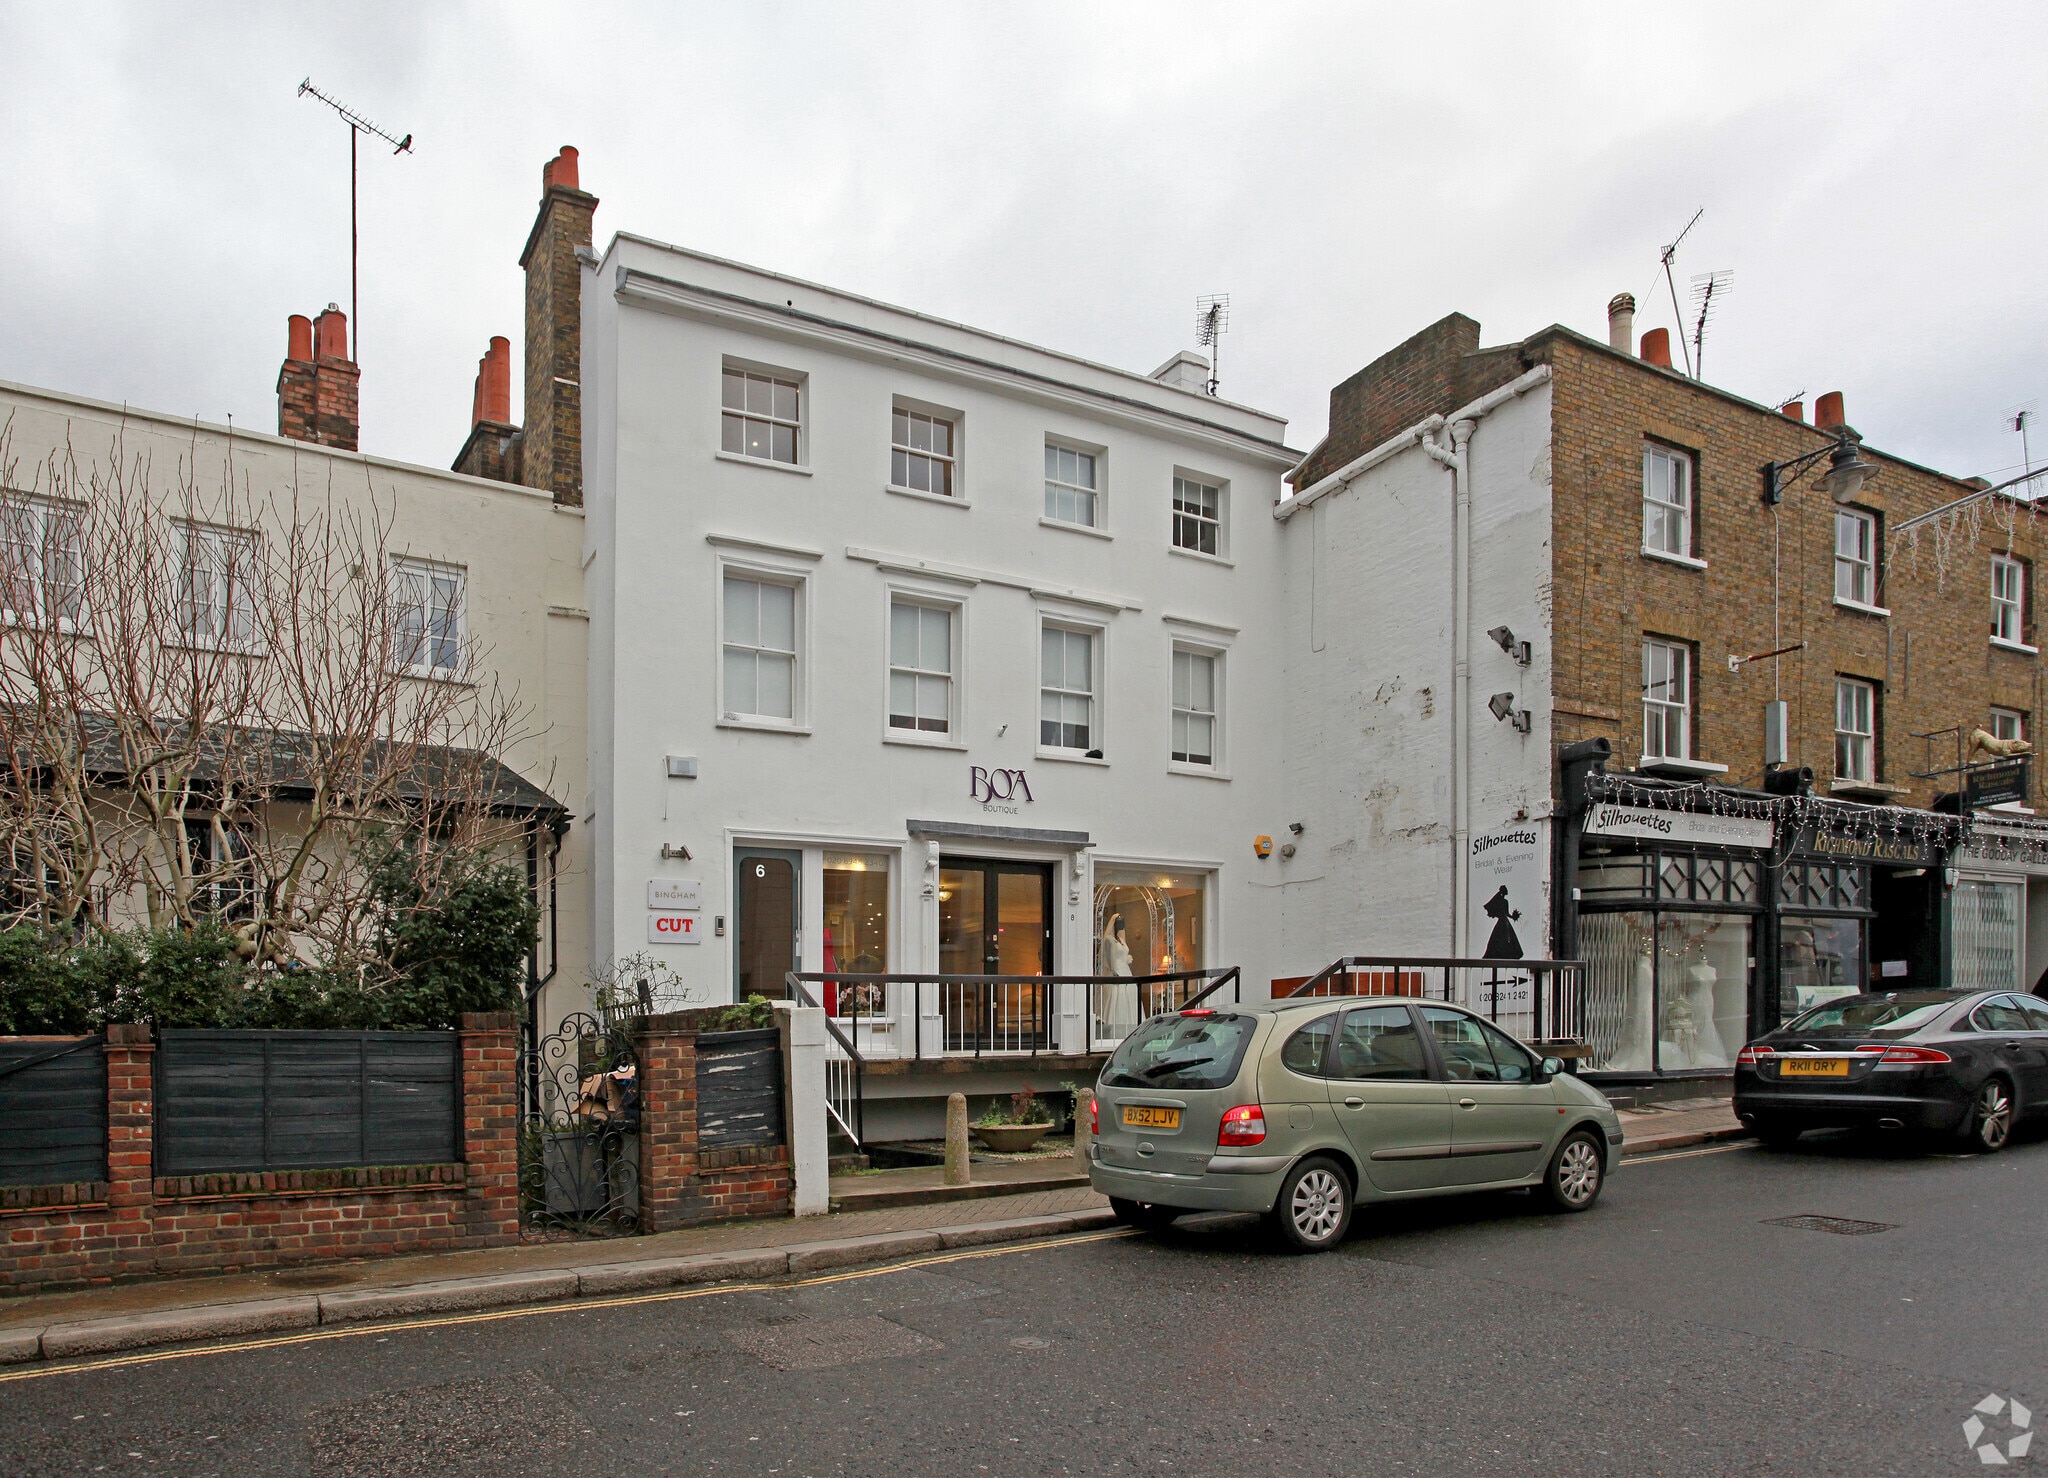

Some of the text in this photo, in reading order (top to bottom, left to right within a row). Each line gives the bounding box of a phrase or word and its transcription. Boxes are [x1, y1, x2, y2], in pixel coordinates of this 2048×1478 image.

[970, 766, 1034, 803] BOA
[983, 805, 1018, 814] BOUTIQUE
[1597, 809, 1672, 834] Silhouettes
[1472, 830, 1537, 855] Silhouettes
[1475, 858, 1494, 868] Bridal
[1506, 852, 1534, 863] Evening
[1963, 847, 1979, 858] THE
[1982, 848, 2018, 862] GOODAY
[755, 864, 766, 878] 6
[1494, 866, 1513, 874] Wear
[655, 891, 696, 899] BINGHAM
[656, 918, 694, 933] CUT
[1127, 1108, 1175, 1124] BX52 LJV
